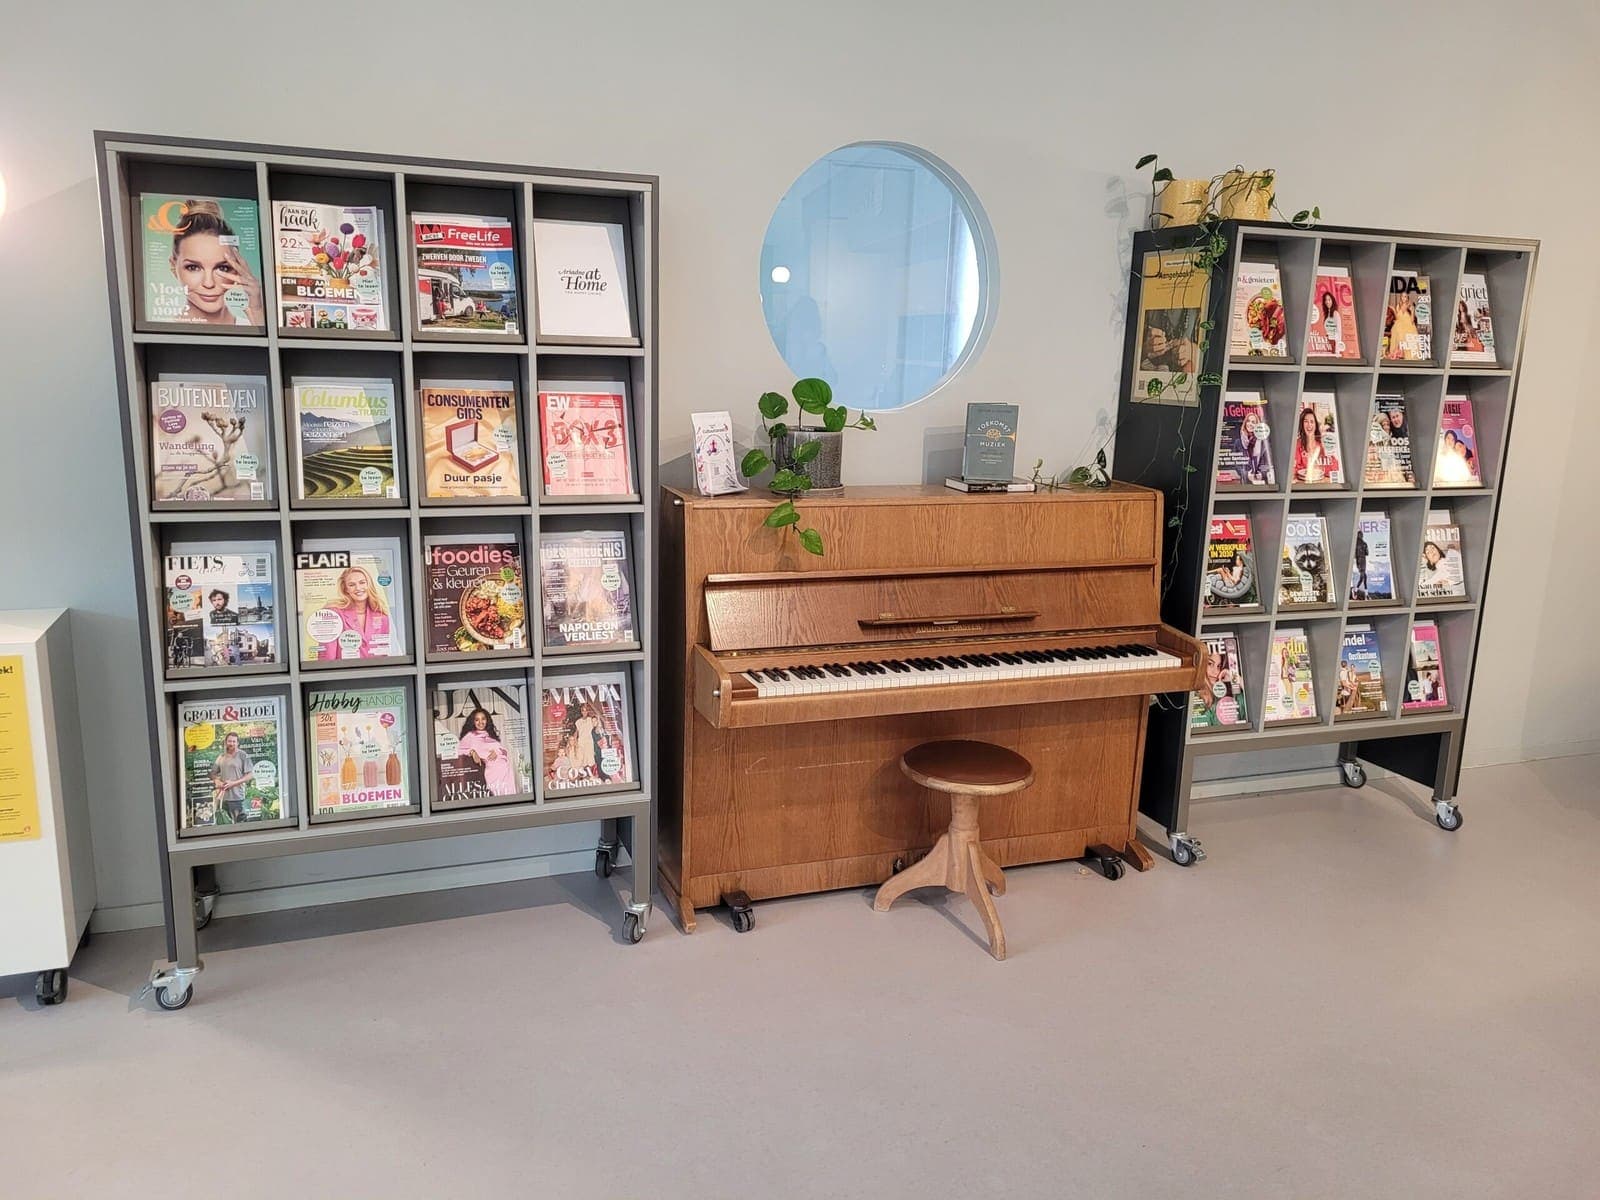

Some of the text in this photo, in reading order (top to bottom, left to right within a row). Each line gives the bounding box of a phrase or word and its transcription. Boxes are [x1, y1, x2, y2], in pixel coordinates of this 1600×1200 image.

[280, 207, 321, 230] haak
[448, 228, 500, 242] FreeLife
[422, 253, 487, 263] ZWERVEN DOOR ZWEDEN
[585, 267, 601, 280] at
[151, 282, 190, 297] Moet
[561, 276, 608, 292] Home
[155, 295, 181, 306] dat
[153, 304, 191, 316] nou?
[158, 388, 257, 408] BUITENLEVEN
[301, 388, 388, 409] Columbus
[427, 394, 510, 408] CONSUMENTEN
[456, 408, 482, 420] GIDS
[977, 420, 1011, 433] TOEKOMST
[160, 442, 215, 453] Wandeling
[444, 473, 502, 485] Duur pasje
[296, 552, 349, 569] FLAIR
[431, 545, 513, 565] foodies
[166, 555, 224, 571] FIETS
[447, 565, 491, 577] Geuren
[432, 577, 487, 590] & kleuren
[559, 622, 618, 633] NAPOLEON
[564, 631, 615, 641] VERLIEST
[433, 684, 525, 719] JAN
[549, 684, 621, 705] MAMA
[310, 692, 403, 713] Hobby HANDIG
[183, 704, 275, 723] GROEI & BLOEI
[319, 713, 333, 722] 30x
[556, 764, 596, 780] Cosy
[445, 780, 482, 796] ALLES
[548, 778, 602, 791] Christmas
[342, 789, 402, 804] BLOEMEN
